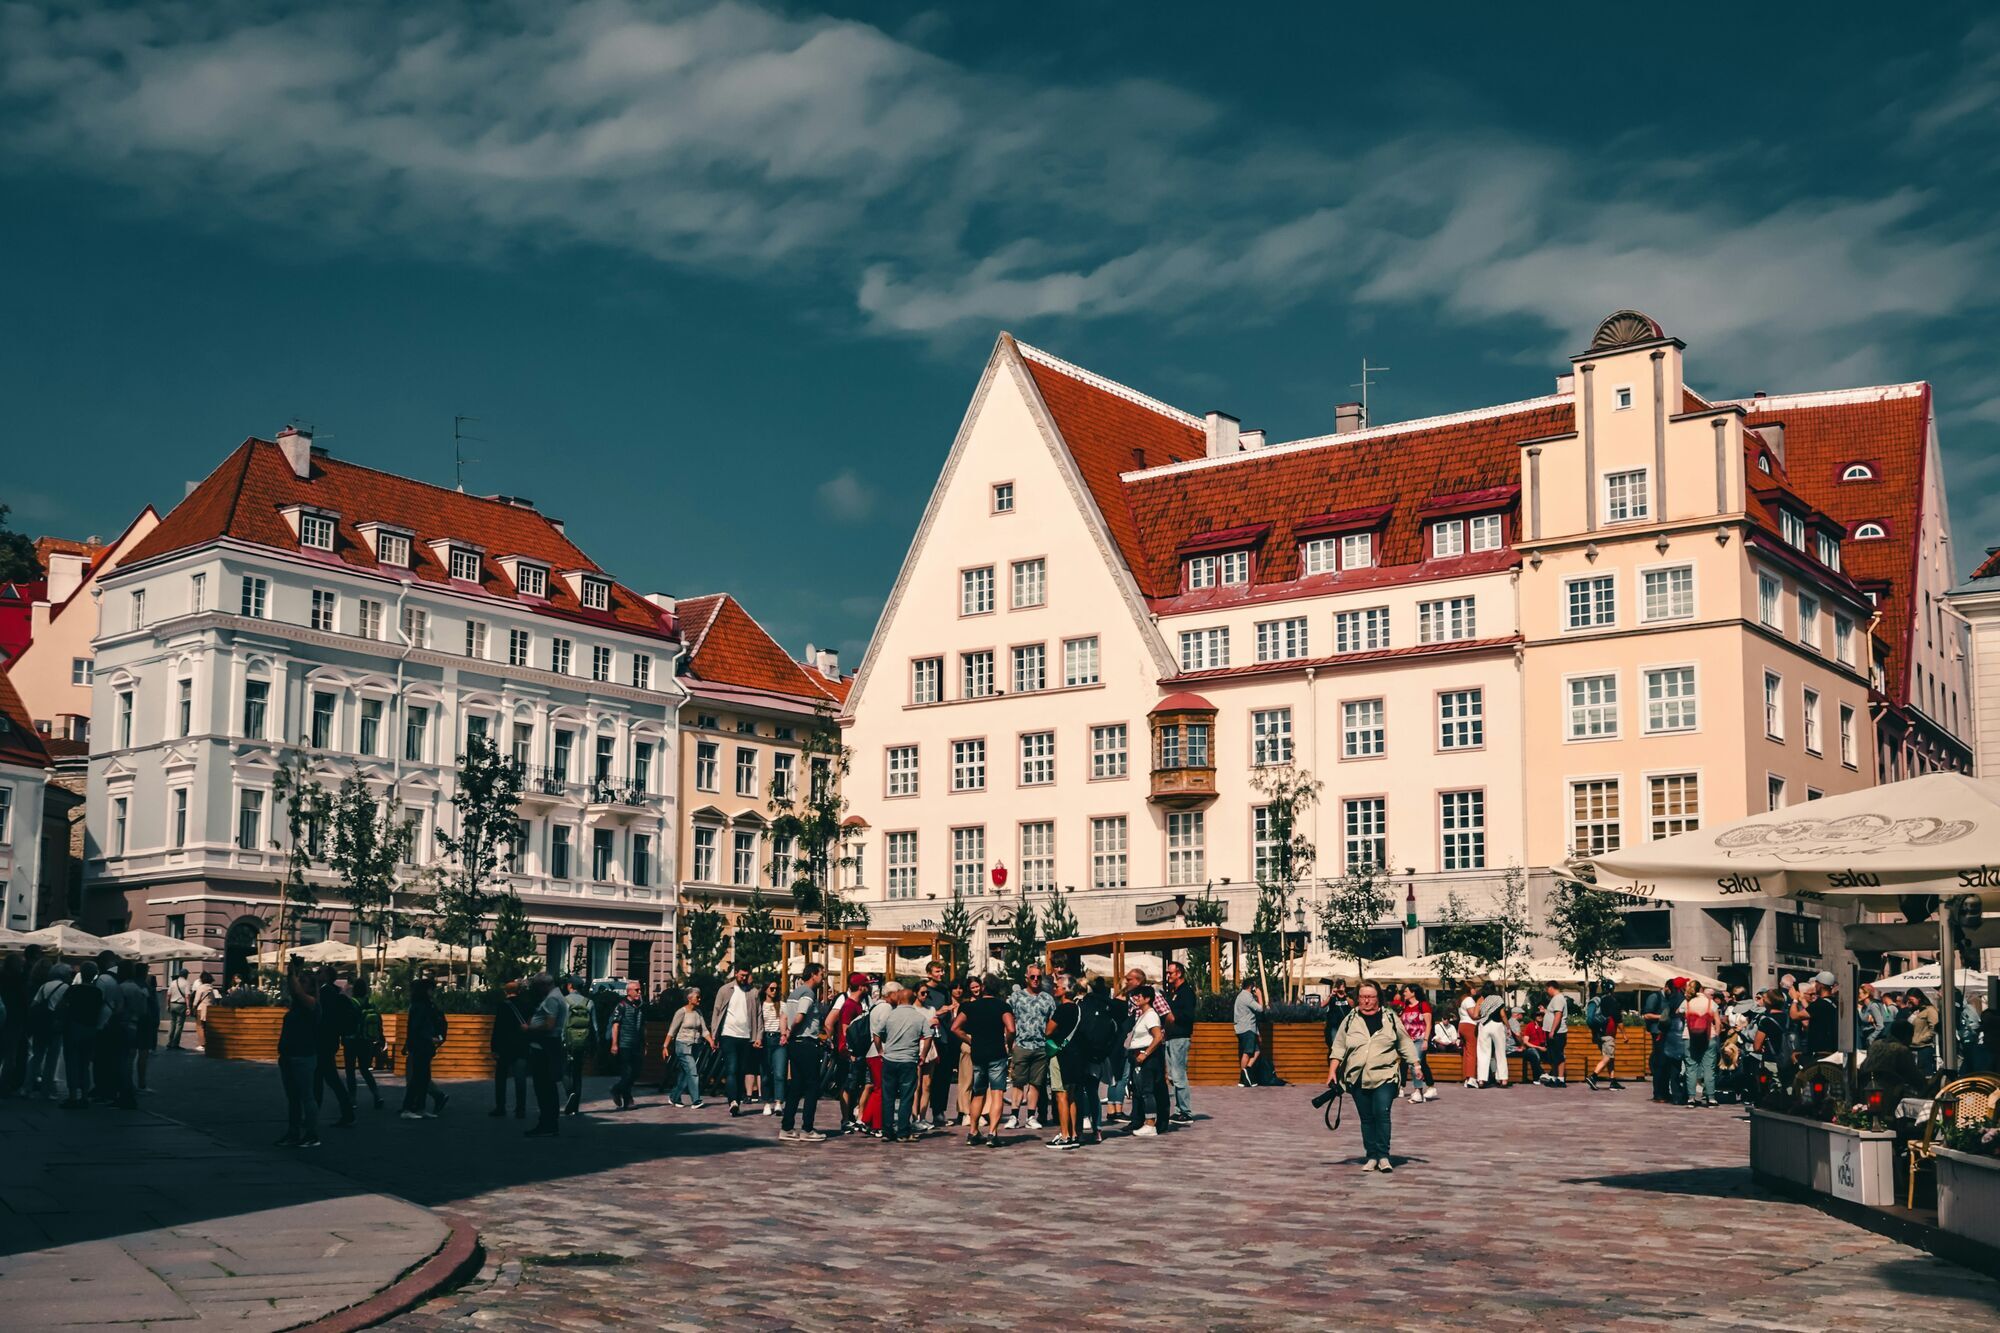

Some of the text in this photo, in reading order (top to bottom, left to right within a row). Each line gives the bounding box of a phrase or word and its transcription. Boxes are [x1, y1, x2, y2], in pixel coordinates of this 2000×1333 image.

[1717, 872, 1761, 895] saku
[1826, 868, 1880, 888] saku
[1957, 865, 2000, 887] sak
